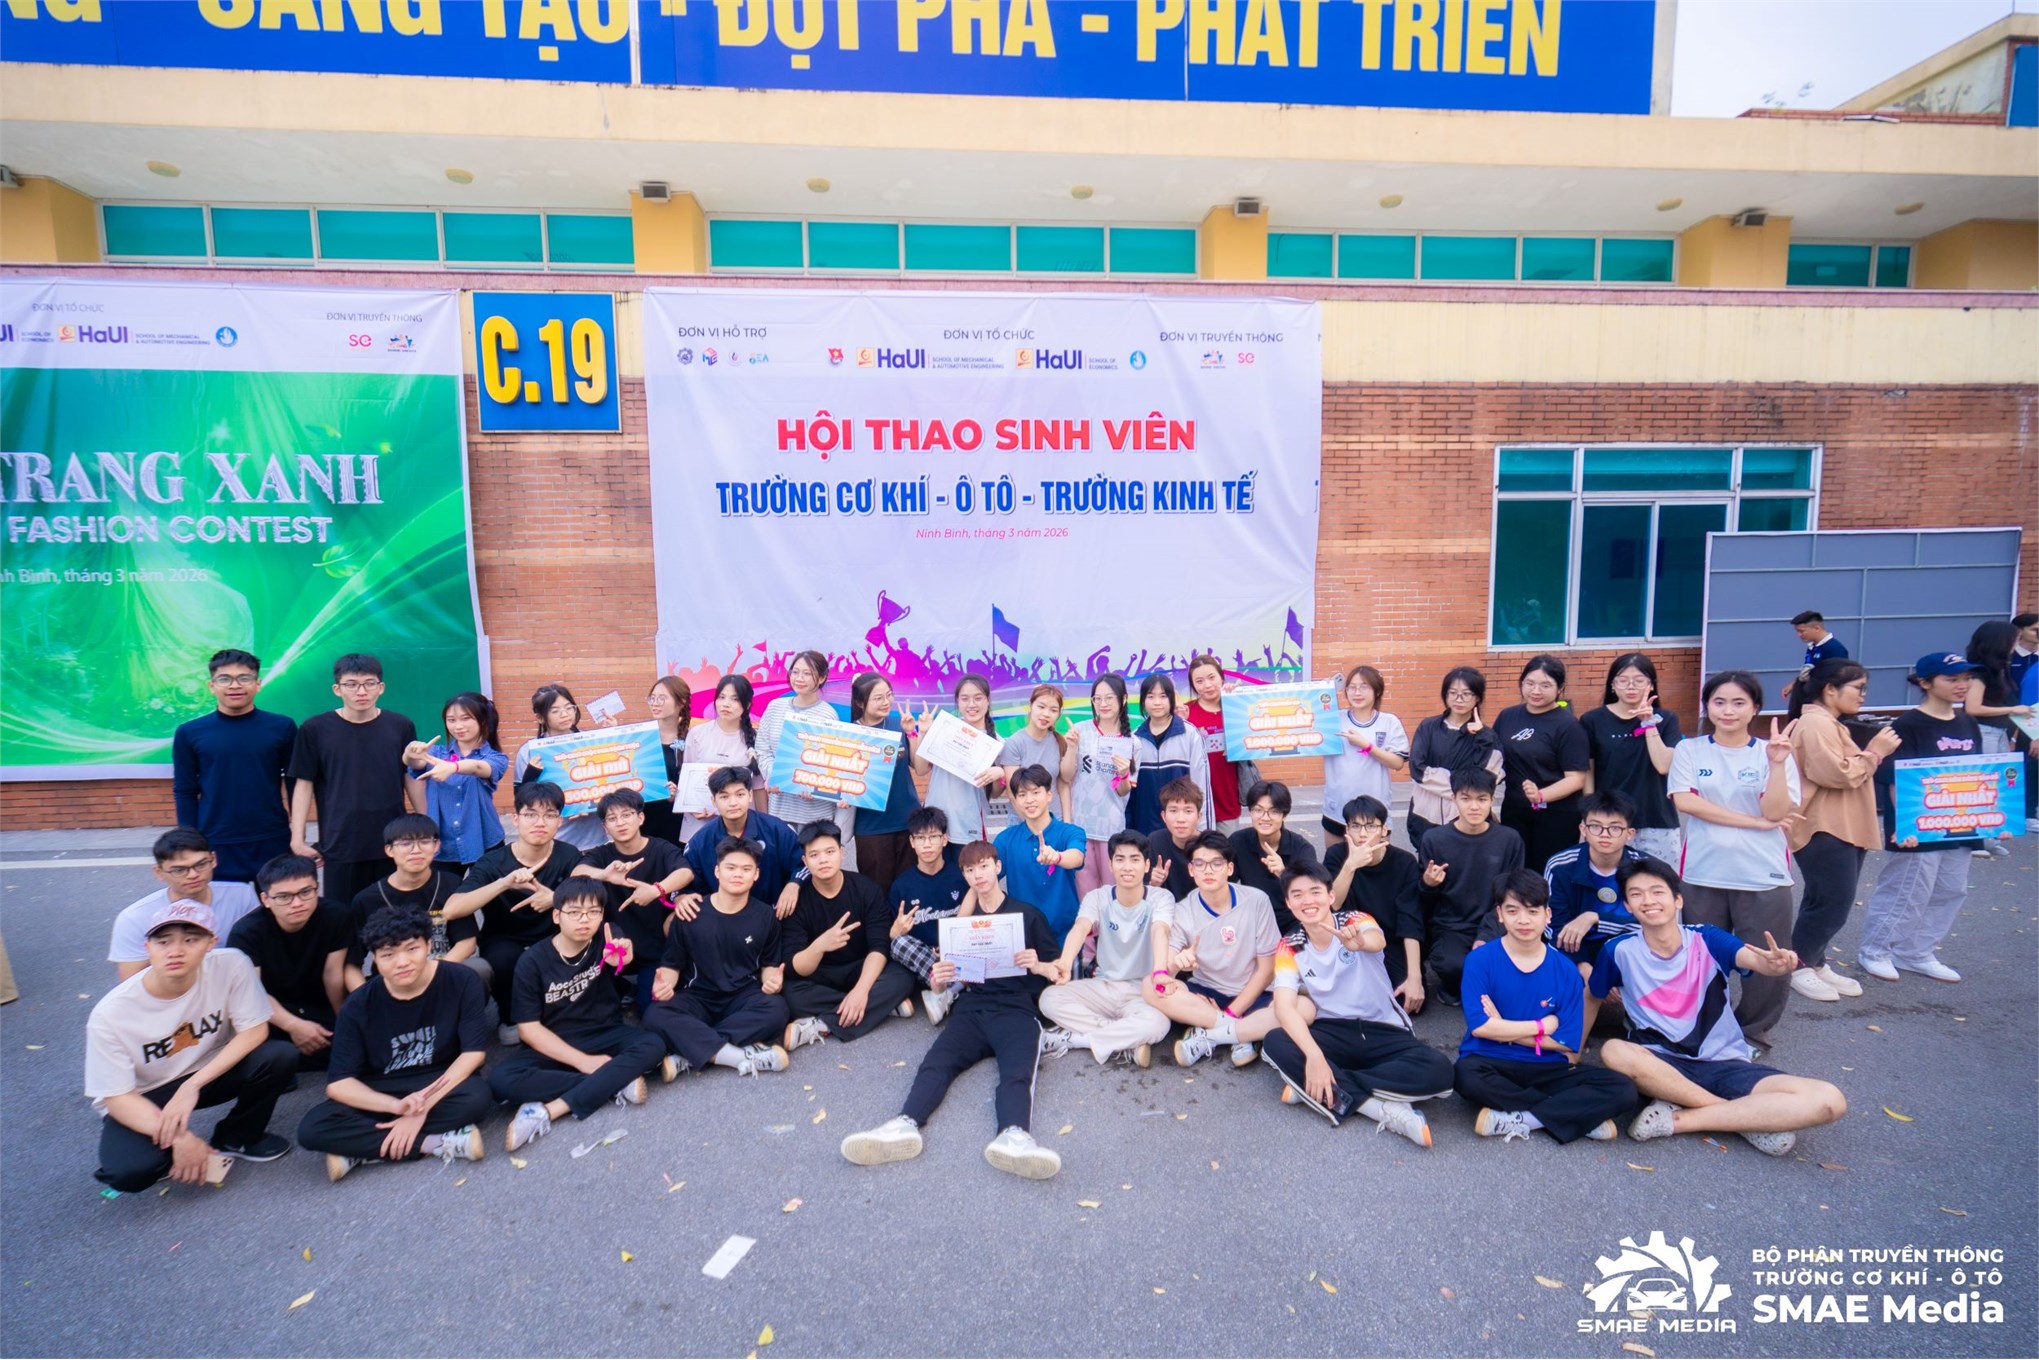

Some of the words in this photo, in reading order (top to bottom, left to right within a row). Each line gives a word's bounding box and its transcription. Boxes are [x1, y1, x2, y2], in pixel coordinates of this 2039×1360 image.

[326, 311, 347, 321] ĐƠN
[348, 313, 357, 323] VỊ
[357, 312, 391, 322] TRUYỀN
[392, 313, 423, 323] THÔNG
[78, 325, 129, 344] HaUI
[678, 326, 705, 338] ĐƠN
[708, 327, 720, 340] VỊ
[722, 324, 741, 338] HỖ
[743, 327, 768, 341] TRỢ
[943, 329, 969, 340] ĐƠN
[972, 330, 983, 342] VỊ
[987, 327, 1001, 340] TỔ
[1003, 328, 1035, 341] CHỨC
[1160, 330, 1184, 342] ĐƠN
[1187, 332, 1198, 343] VỊ
[1200, 331, 1243, 342] TRUYỀN
[1246, 331, 1284, 343] THÔNG
[481, 315, 608, 404] C.19
[877, 348, 926, 369] HaUI
[1035, 349, 1083, 370] HaUI
[777, 410, 853, 460] HỘI
[864, 418, 984, 452] THAO
[994, 418, 1091, 452] SINH
[1102, 410, 1196, 452] VIÊN
[204, 452, 384, 504] XANH
[715, 474, 827, 514] TRƯỜNG
[836, 477, 873, 514] CƠ
[881, 474, 929, 513] KHÍ
[955, 475, 975, 513] Ô
[980, 474, 1014, 513] TÔ
[1040, 473, 1144, 512] TRƯỜNG
[1153, 480, 1214, 512] KINH
[1221, 470, 1258, 512] TẾ
[8, 515, 160, 543] FASHION
[169, 515, 333, 544] CONTEST
[916, 528, 941, 539] Ninh
[944, 528, 971, 540] Bình,
[974, 528, 1006, 540] tháng
[1007, 528, 1015, 538] 3
[1017, 528, 1042, 538] năm
[1044, 527, 1069, 538] 2026
[19, 568, 62, 585] Bình,
[64, 568, 113, 586] tháng
[115, 568, 126, 583] 3
[128, 568, 165, 583] năm
[169, 568, 209, 583] 2026
